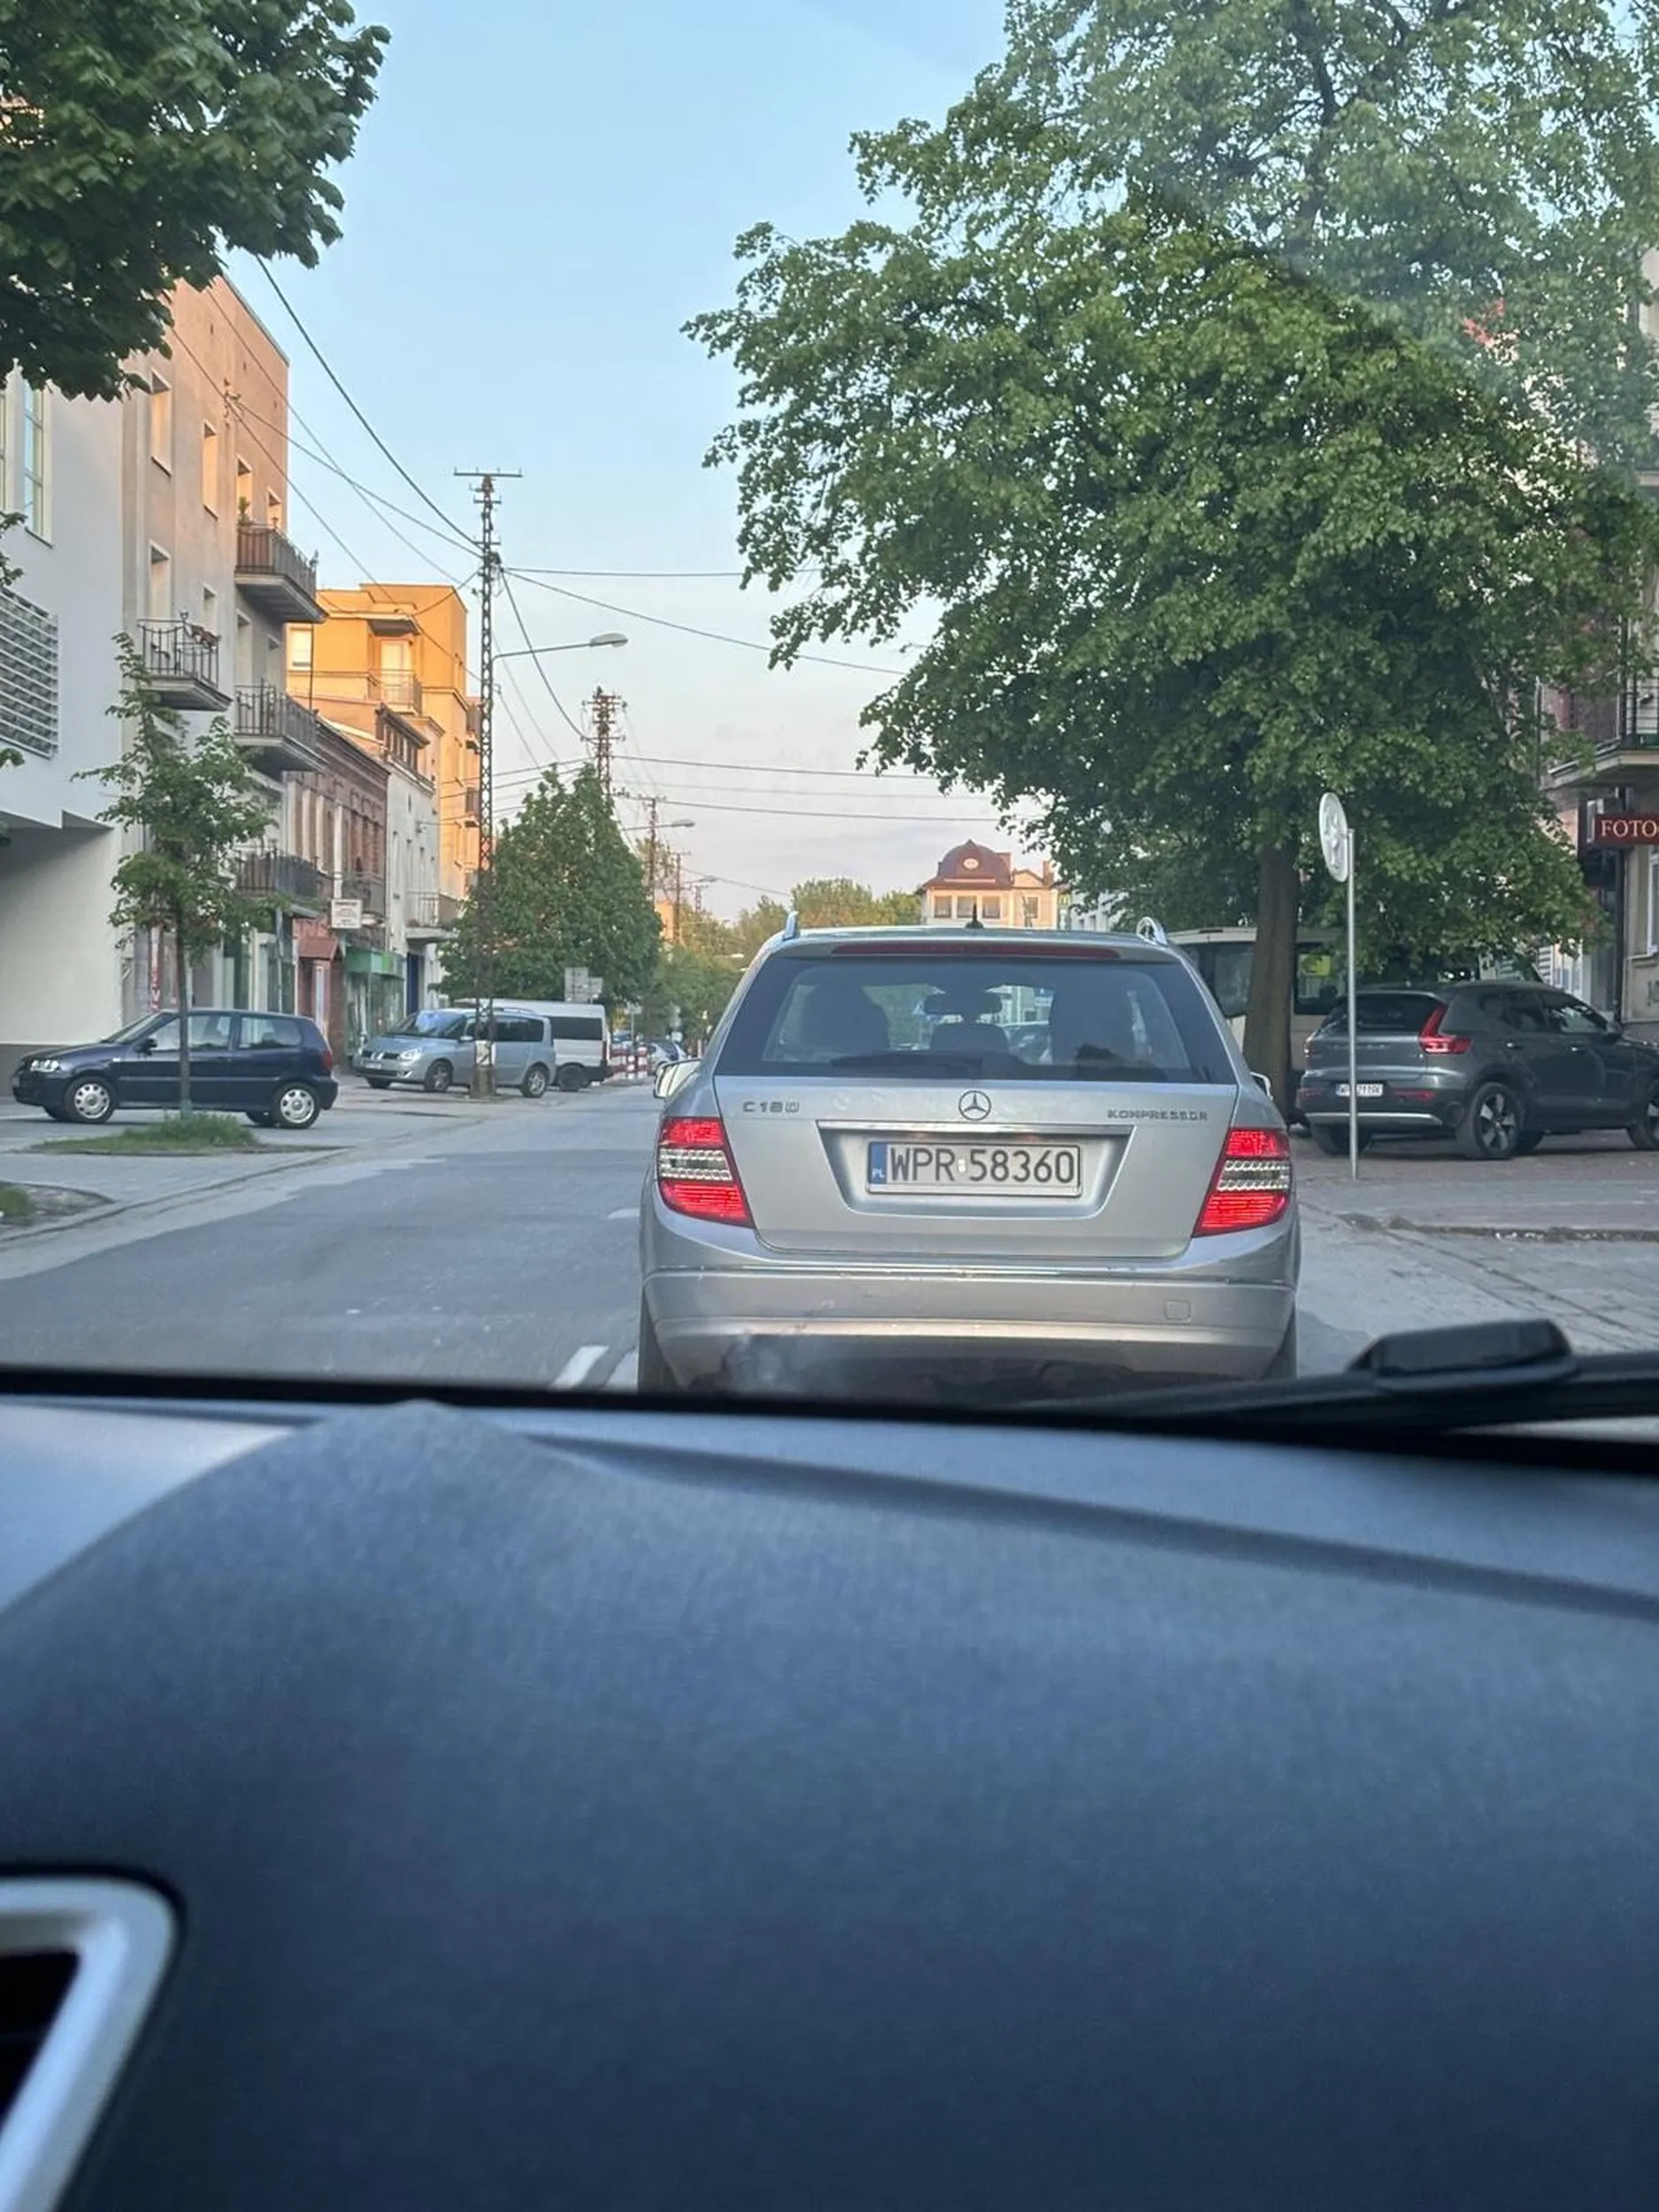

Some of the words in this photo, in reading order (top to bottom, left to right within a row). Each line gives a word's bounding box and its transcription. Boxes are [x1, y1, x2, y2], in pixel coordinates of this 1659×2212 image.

[1601, 819, 1659, 838] FOTO
[1107, 1110, 1208, 1121] KOMPRESSOR
[890, 1147, 956, 1181] WPR
[969, 1148, 1075, 1183] 58360
